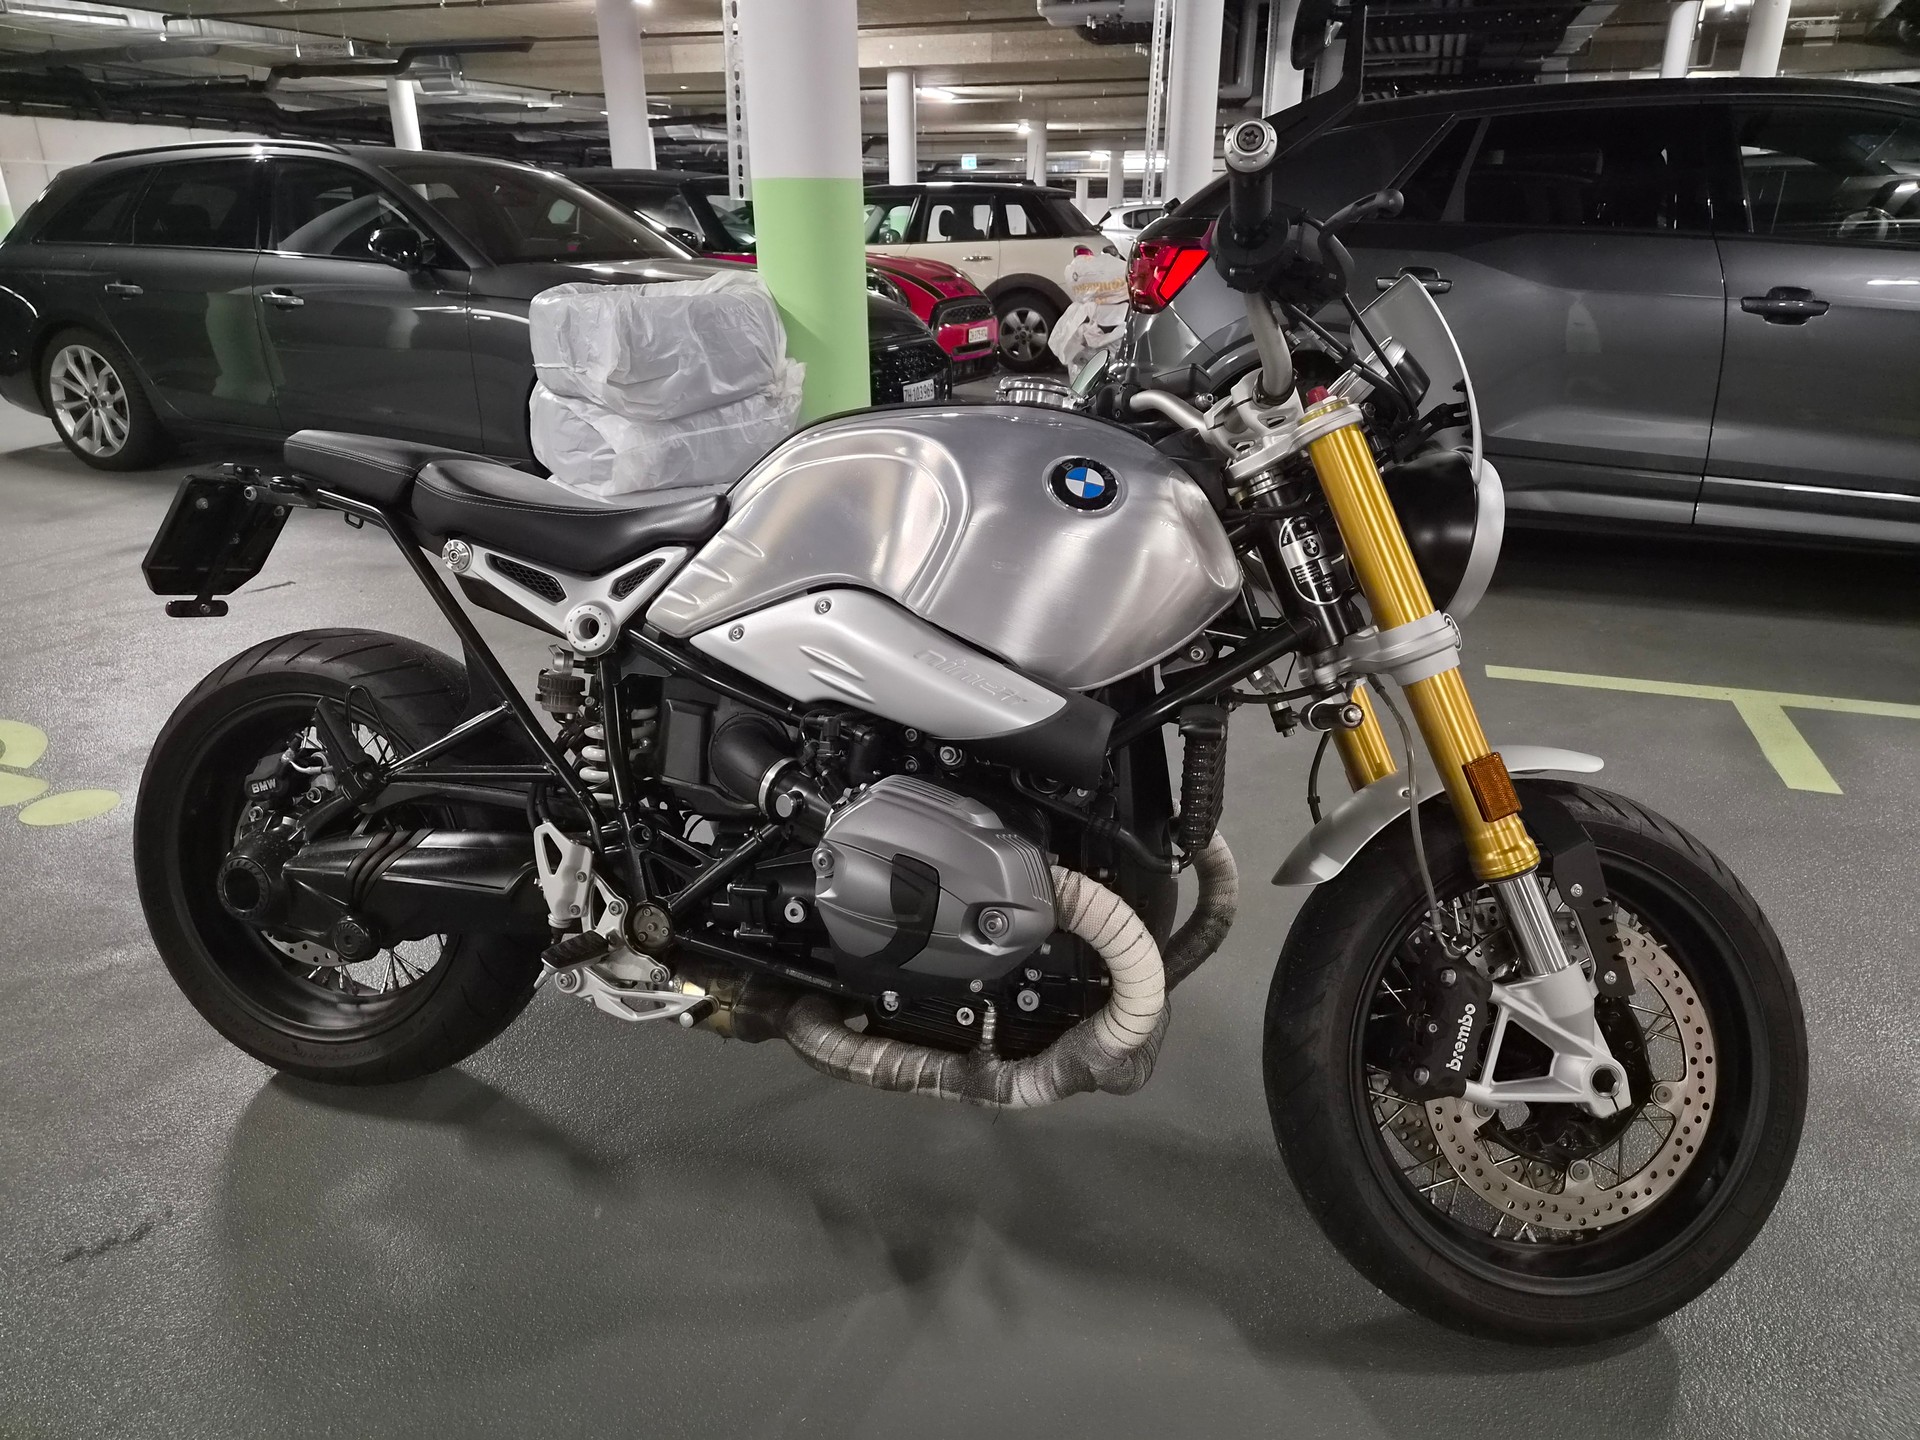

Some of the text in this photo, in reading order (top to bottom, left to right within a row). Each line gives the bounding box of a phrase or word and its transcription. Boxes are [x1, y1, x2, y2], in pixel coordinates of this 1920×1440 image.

[1061, 459, 1114, 481] BMW
[251, 778, 276, 794] BMW
[1445, 1003, 1476, 1072] brembo
